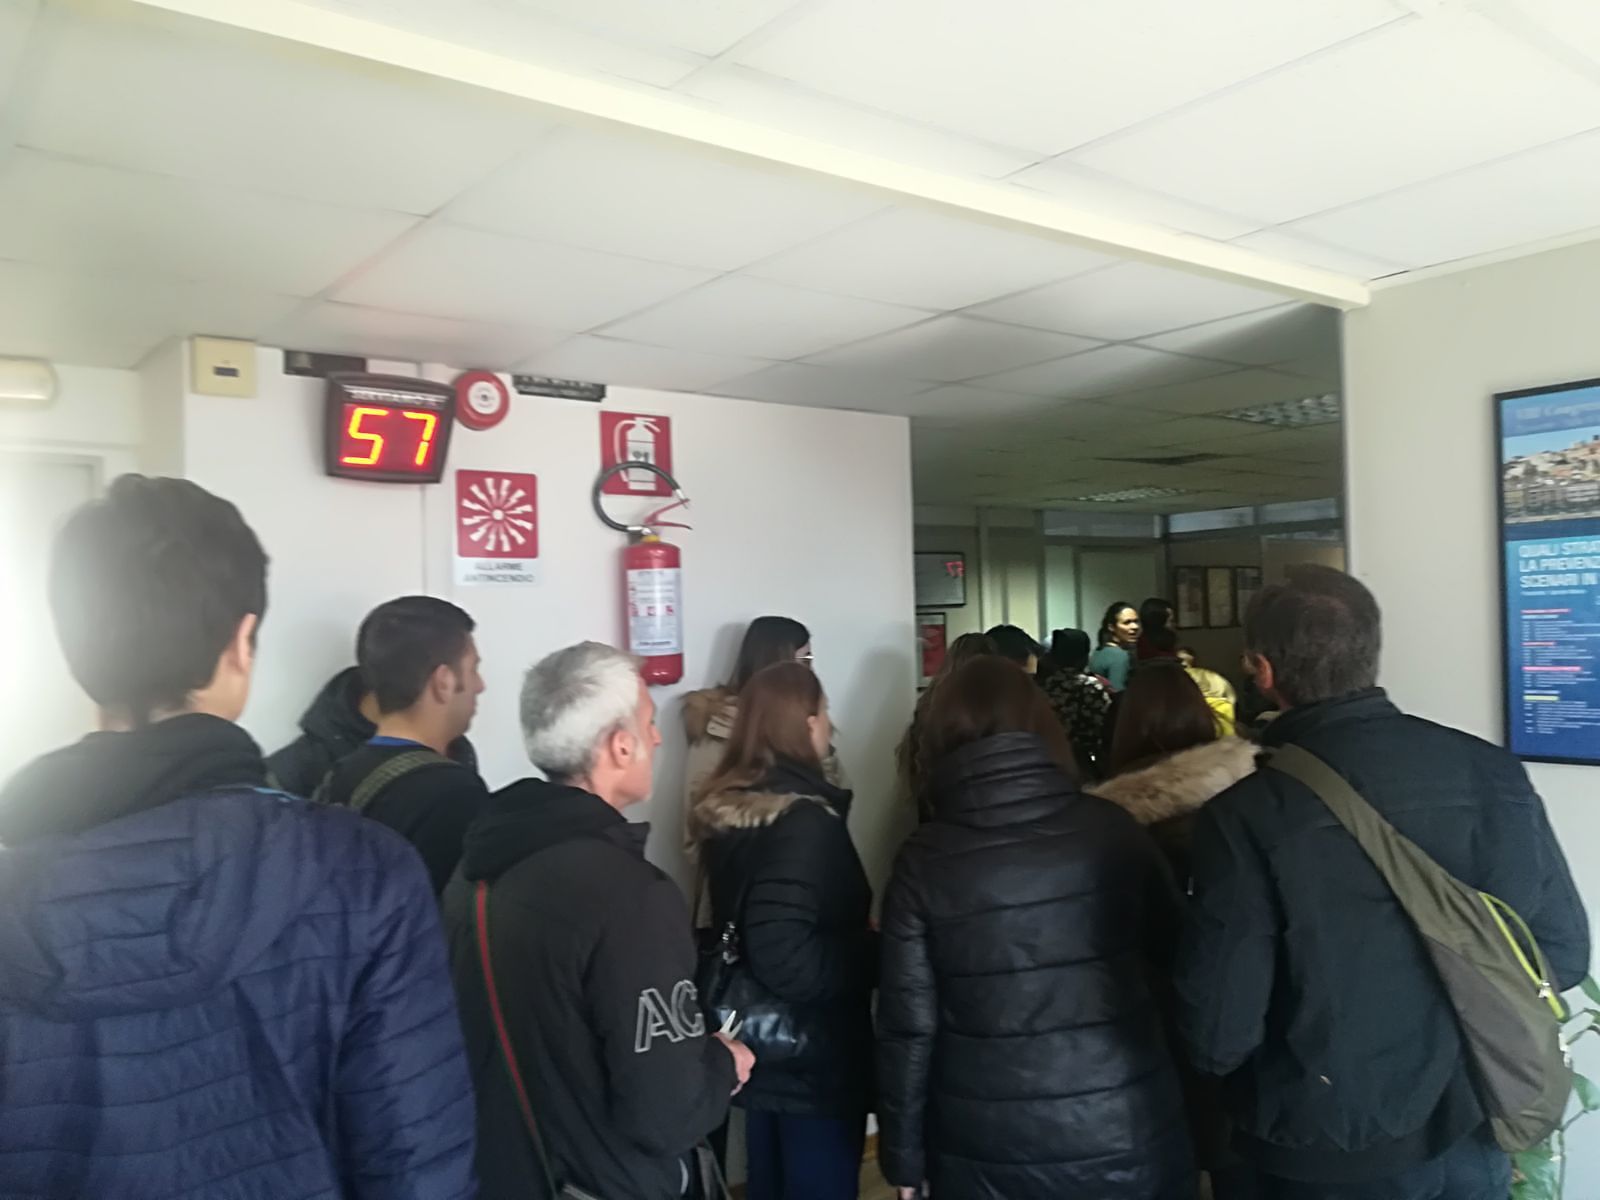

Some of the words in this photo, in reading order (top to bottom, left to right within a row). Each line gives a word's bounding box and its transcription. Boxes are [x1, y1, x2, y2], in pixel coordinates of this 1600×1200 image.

[339, 406, 437, 466] 57
[474, 562, 523, 571] ALLARME
[1519, 559, 1538, 573] LA
[1520, 573, 1578, 588] SCENARI
